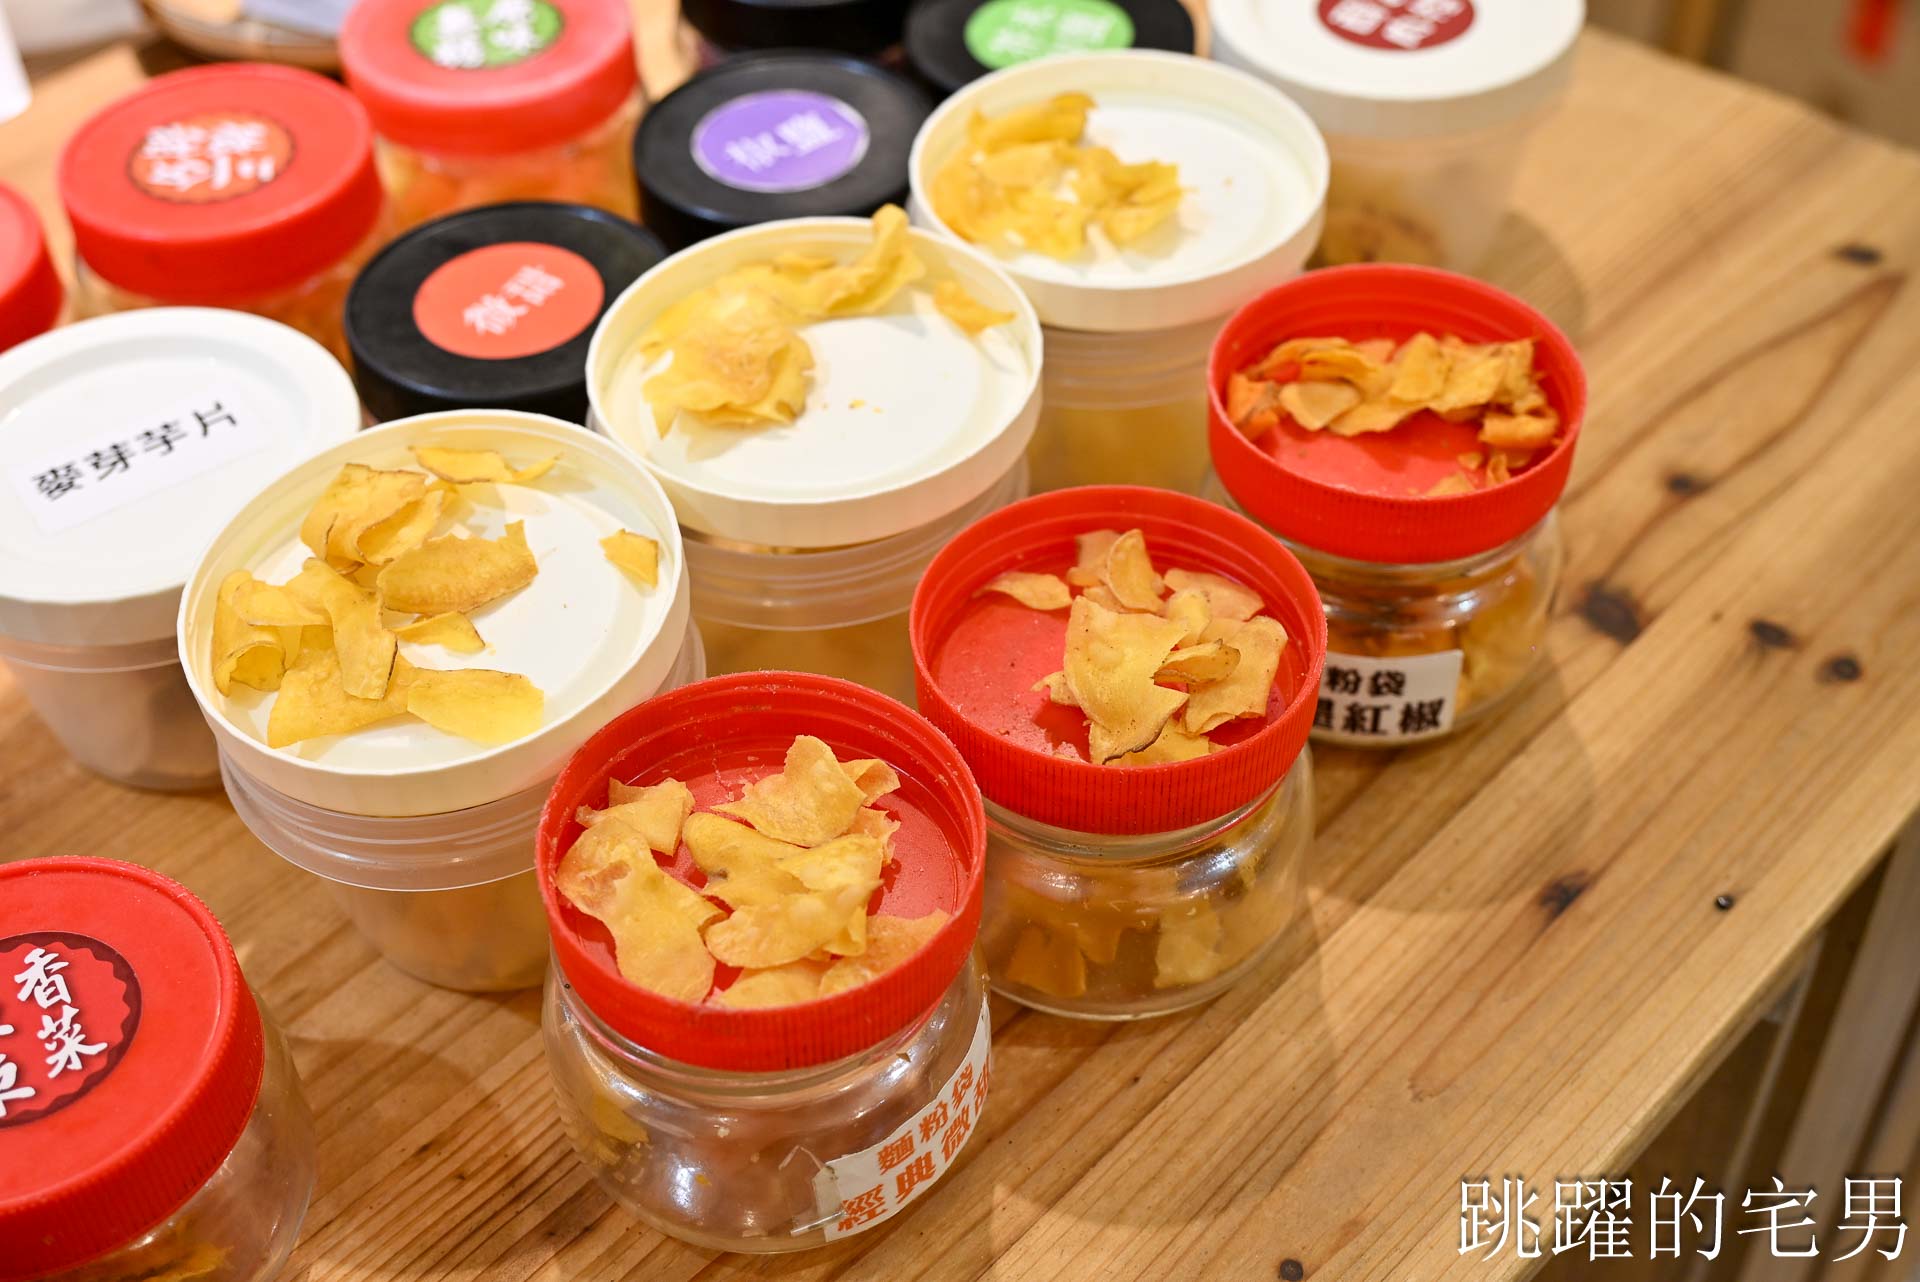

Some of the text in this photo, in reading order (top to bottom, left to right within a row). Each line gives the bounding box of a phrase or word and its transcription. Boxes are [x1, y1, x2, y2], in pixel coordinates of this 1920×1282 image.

[31, 401, 238, 501] 麥芽芋片
[1325, 666, 1406, 697] 粉袋
[14, 948, 108, 1079] 香菜
[877, 1061, 974, 1176] 麵粉袋
